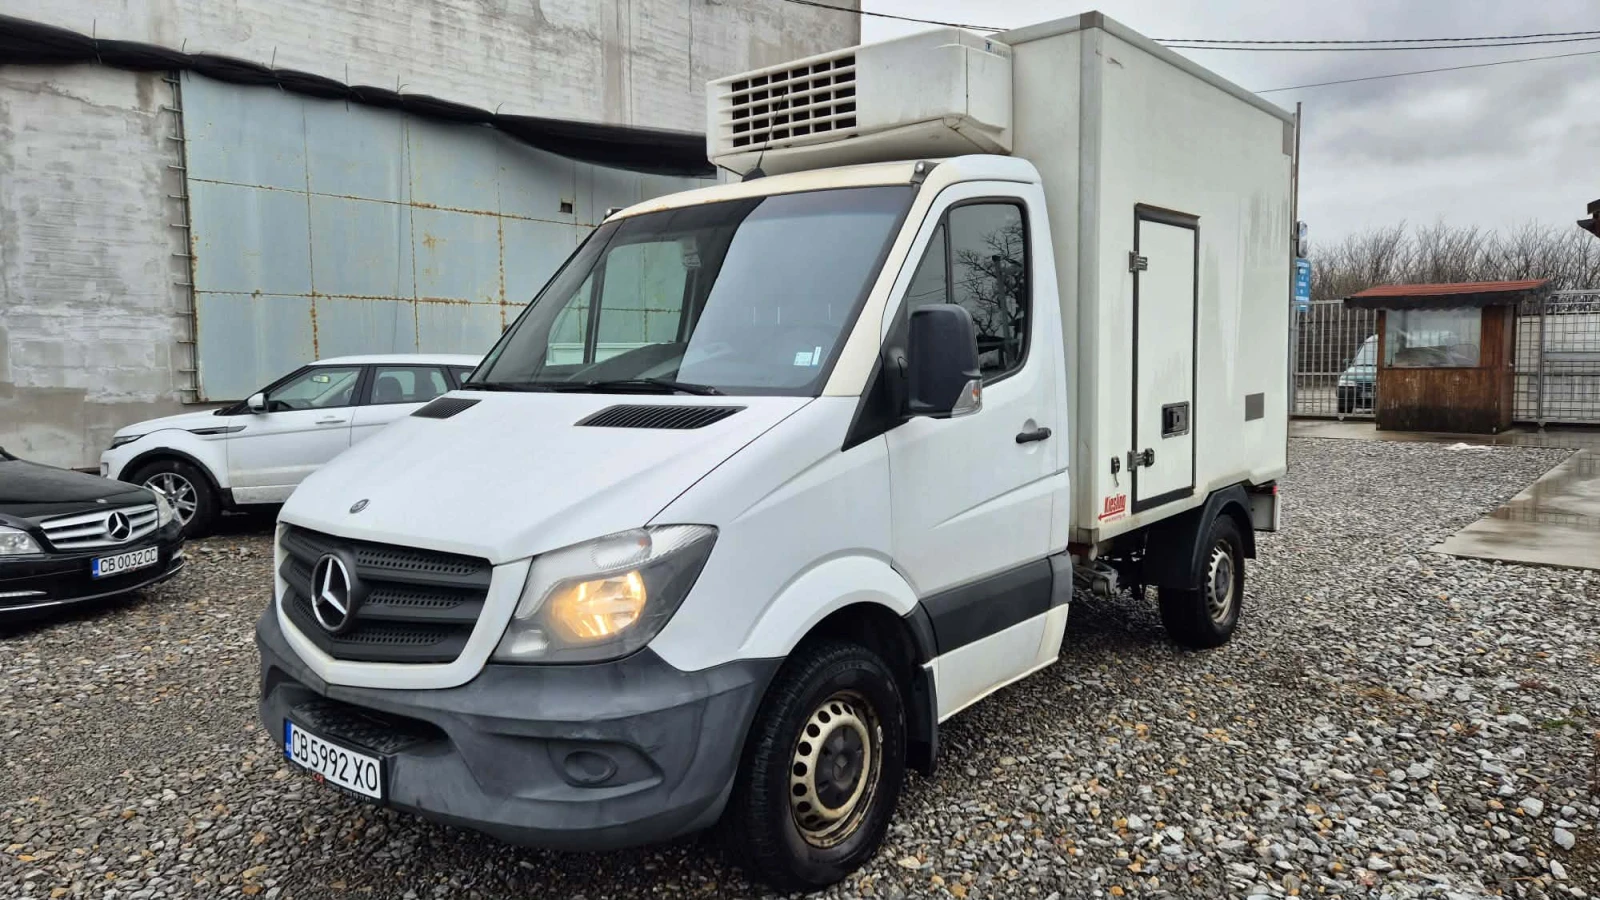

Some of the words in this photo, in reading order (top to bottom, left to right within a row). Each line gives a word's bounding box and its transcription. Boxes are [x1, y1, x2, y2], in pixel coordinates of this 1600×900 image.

[100, 558, 115, 573] CB
[118, 551, 143, 569] 0032
[292, 729, 308, 762] CB
[311, 739, 349, 783] 5992
